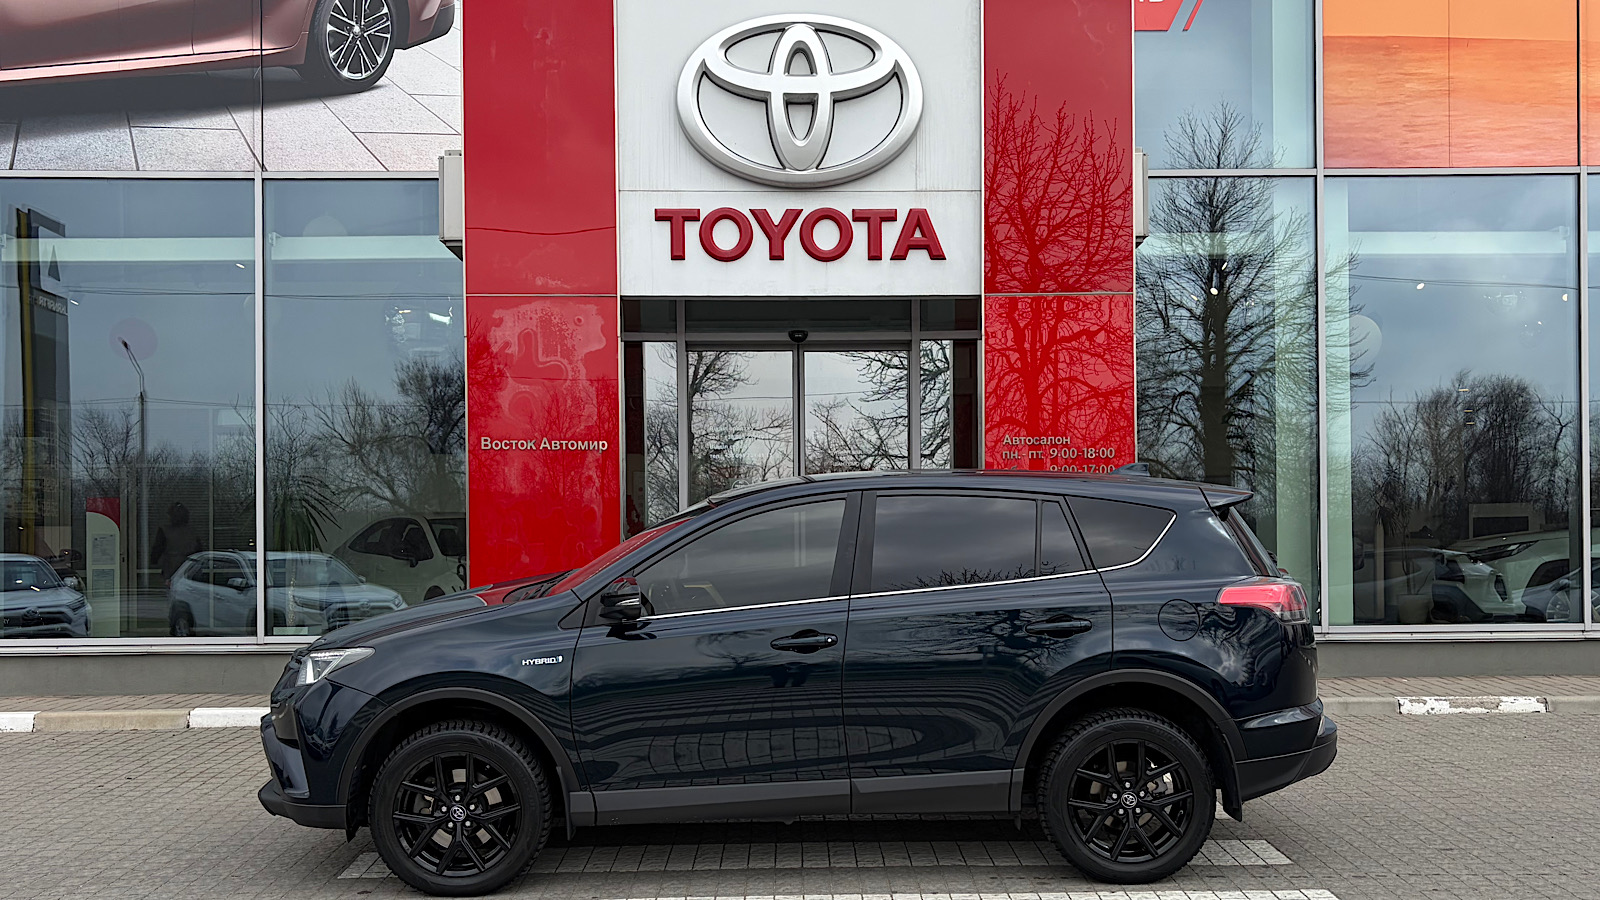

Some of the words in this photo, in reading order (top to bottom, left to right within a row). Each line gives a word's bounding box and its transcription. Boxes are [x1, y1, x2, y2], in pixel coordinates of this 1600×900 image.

[655, 207, 947, 262] TOYOTA
[480, 437, 536, 450] Восток
[539, 437, 608, 454] Автомир
[1002, 434, 1071, 445] Автосалон
[1050, 447, 1116, 459] 9:00-18:00
[522, 657, 557, 666] HYBRID
